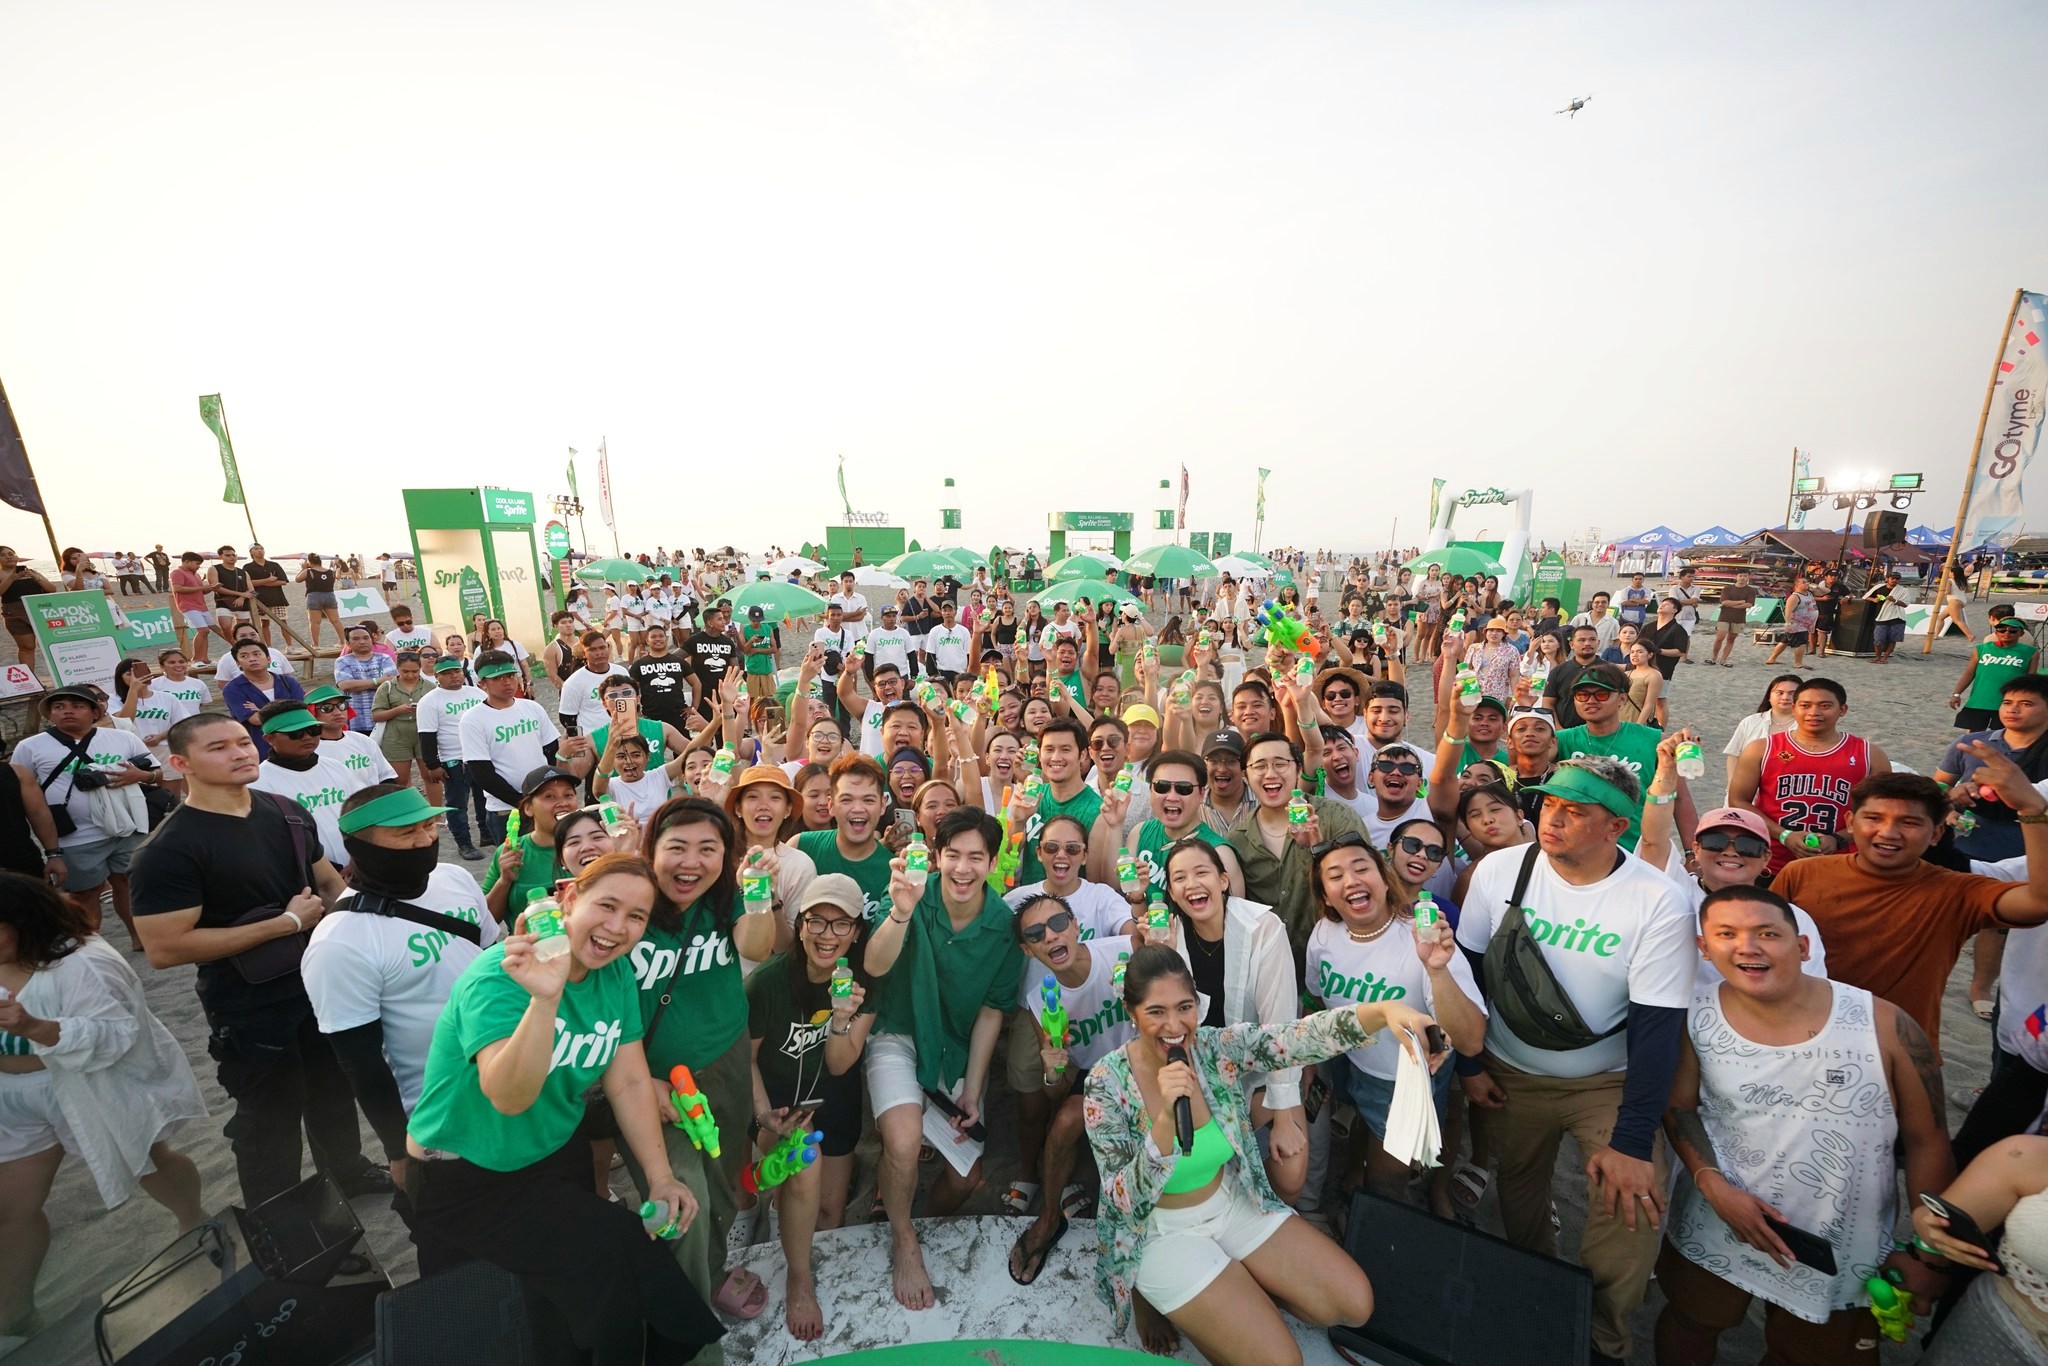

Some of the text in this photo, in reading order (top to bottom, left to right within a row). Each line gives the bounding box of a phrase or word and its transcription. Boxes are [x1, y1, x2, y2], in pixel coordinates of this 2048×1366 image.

[1458, 487, 1508, 508] Sprite
[503, 504, 527, 516] Sprite
[1077, 519, 1098, 528] Sprite
[932, 563, 955, 571] Sprite
[1192, 564, 1211, 572] Sprite
[39, 605, 91, 619] TAPON
[396, 637, 427, 649] Sprite
[696, 643, 732, 655] BOUNCER
[878, 637, 903, 647] Sprite
[938, 637, 962, 647] Sprite
[1978, 653, 2024, 667] Sprite
[639, 662, 682, 675] BOUNCER
[445, 698, 482, 716] Sprite
[495, 718, 539, 743] Sprite
[344, 753, 370, 770] rite
[715, 759, 733, 767] Sprite
[1776, 773, 1851, 807] BULLS
[296, 787, 346, 815] Sprite
[1779, 799, 1839, 835] 23
[1119, 865, 1132, 878] Sprite
[743, 881, 760, 896] Sprite
[1151, 911, 1165, 924] Sprite
[630, 930, 733, 990] Sprite
[1319, 960, 1407, 1003] Sprite
[1739, 1063, 1895, 1119] Mr. Lee
[1716, 1134, 1766, 1167] Lee
[1788, 1129, 1857, 1214] Lee
